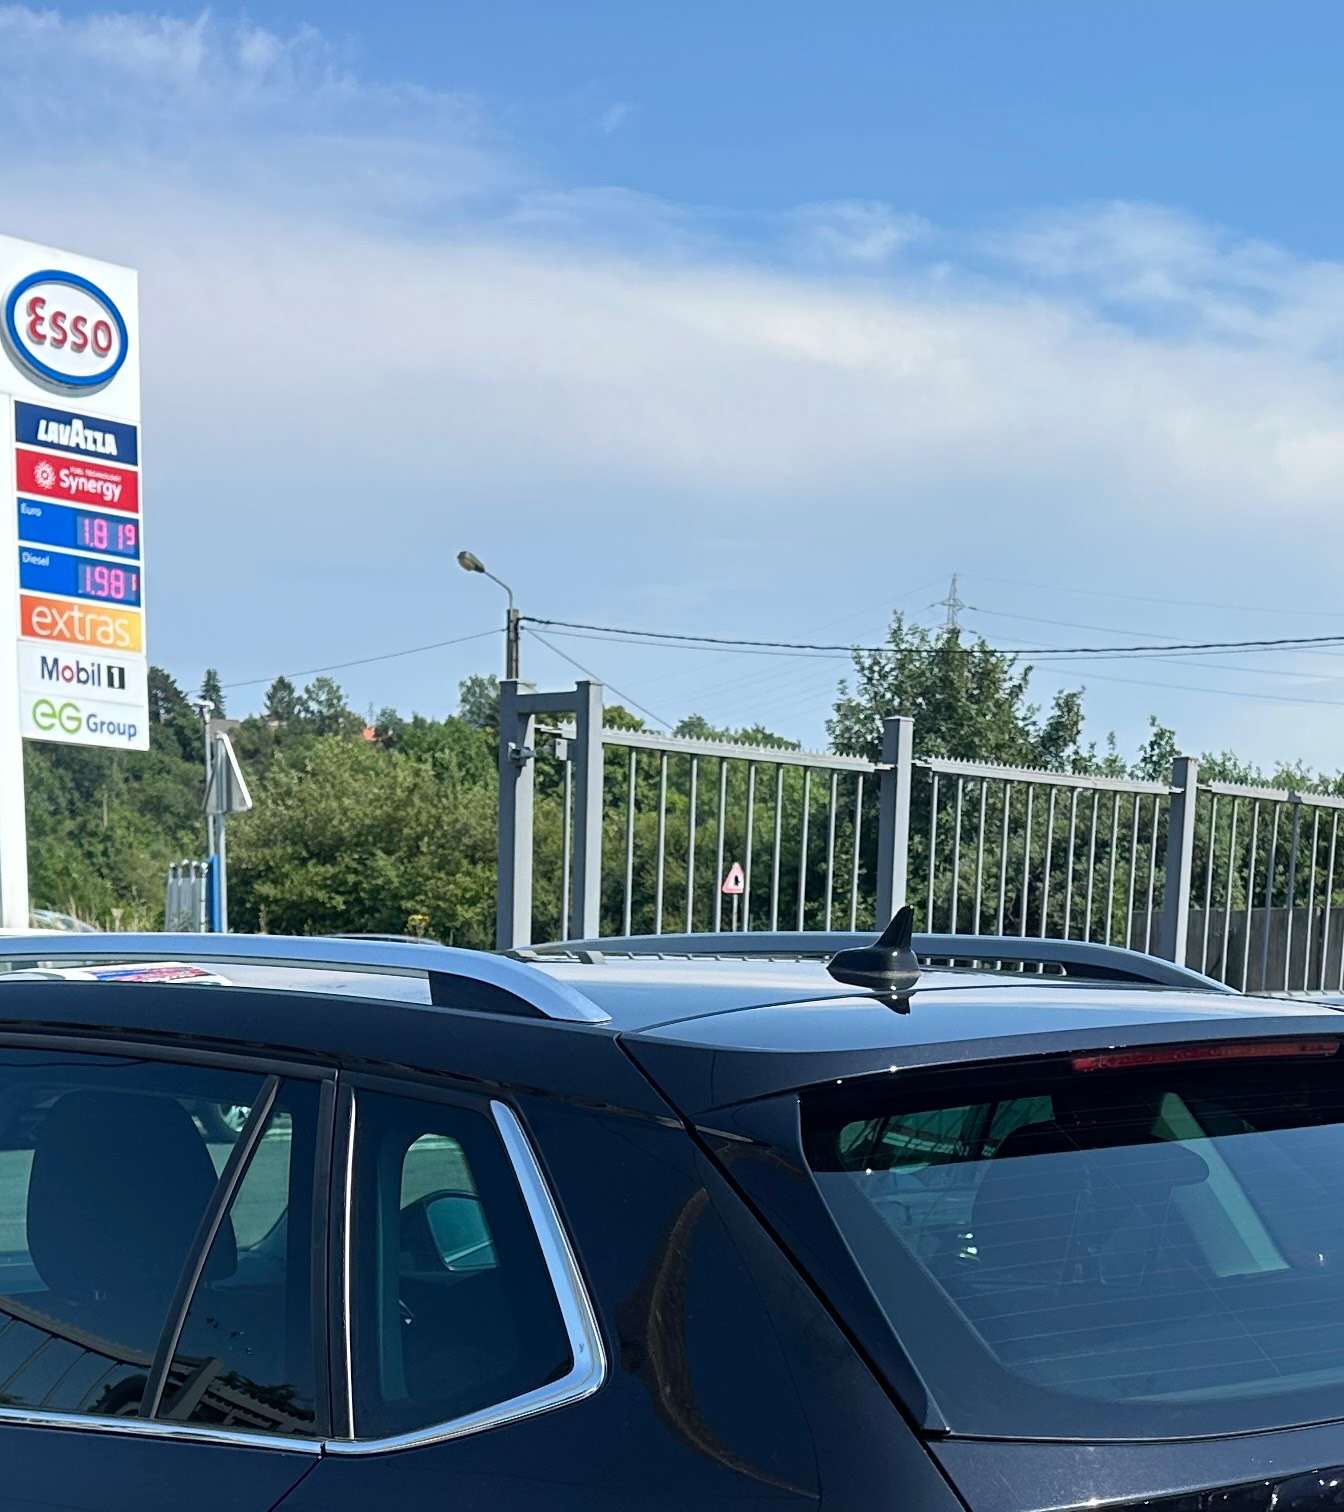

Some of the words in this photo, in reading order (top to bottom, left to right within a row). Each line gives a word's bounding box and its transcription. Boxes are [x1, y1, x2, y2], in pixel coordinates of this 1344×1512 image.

[37, 418, 118, 456] LAVAZZA
[59, 468, 122, 503] Synergy
[22, 551, 50, 567] Diesel
[32, 605, 131, 647] extras
[40, 655, 102, 687] Mobil
[109, 666, 124, 689] 1
[86, 713, 137, 741] Group
